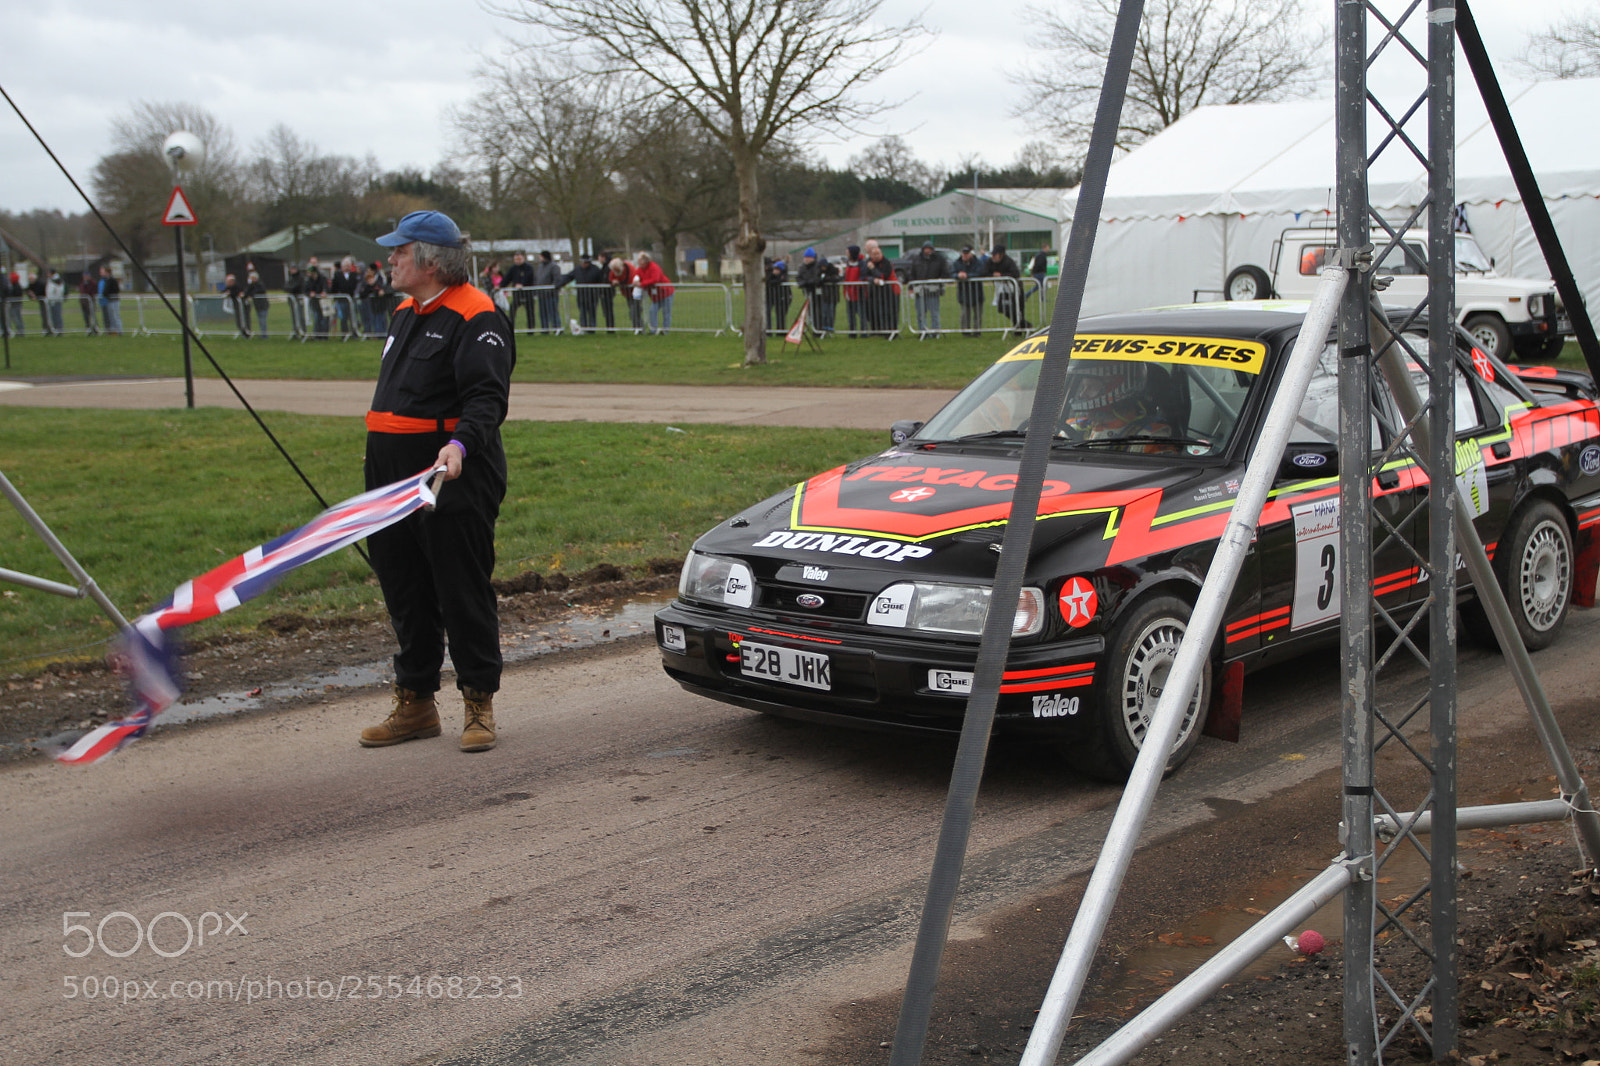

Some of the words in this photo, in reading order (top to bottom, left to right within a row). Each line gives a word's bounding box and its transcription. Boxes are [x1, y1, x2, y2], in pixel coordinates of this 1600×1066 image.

[892, 218, 908, 227] THE
[911, 217, 946, 226] KENNEL
[948, 216, 972, 225] CLUB
[1012, 338, 1256, 364] ANREWS-SYKES
[845, 466, 1072, 497] TEXACO
[752, 531, 933, 562] DUNLOP
[802, 566, 829, 581] Valeo
[1317, 544, 1336, 611] 3
[727, 632, 744, 642] TOW
[741, 645, 781, 676] E28
[788, 654, 831, 685] JWK
[1032, 693, 1080, 718] Valeo
